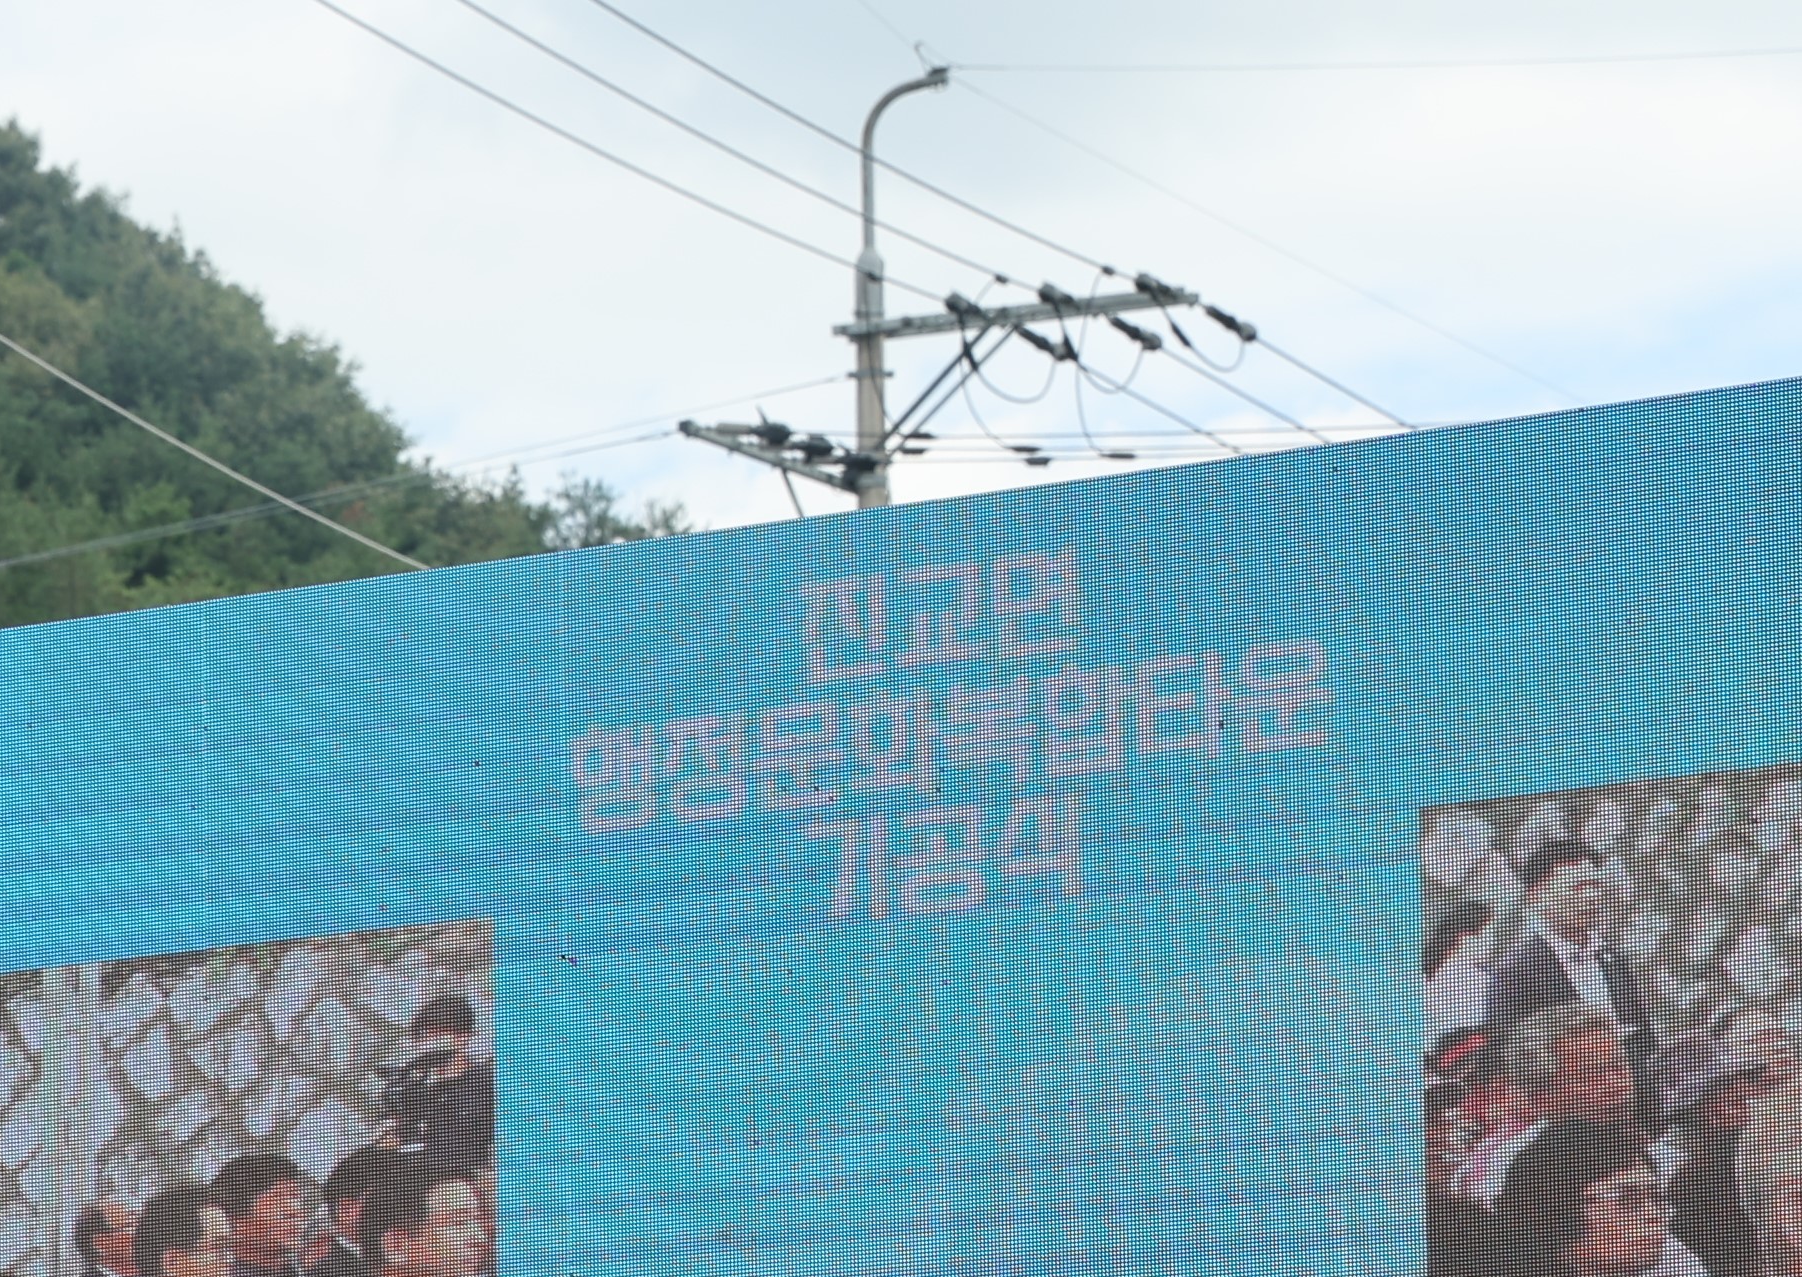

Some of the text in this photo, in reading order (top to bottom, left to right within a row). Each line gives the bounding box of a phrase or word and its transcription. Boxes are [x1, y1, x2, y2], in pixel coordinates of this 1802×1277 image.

[804, 550, 1083, 684] 진교면
[567, 637, 1334, 835] 행정문화복합타운
[806, 796, 1084, 922] 기공식
